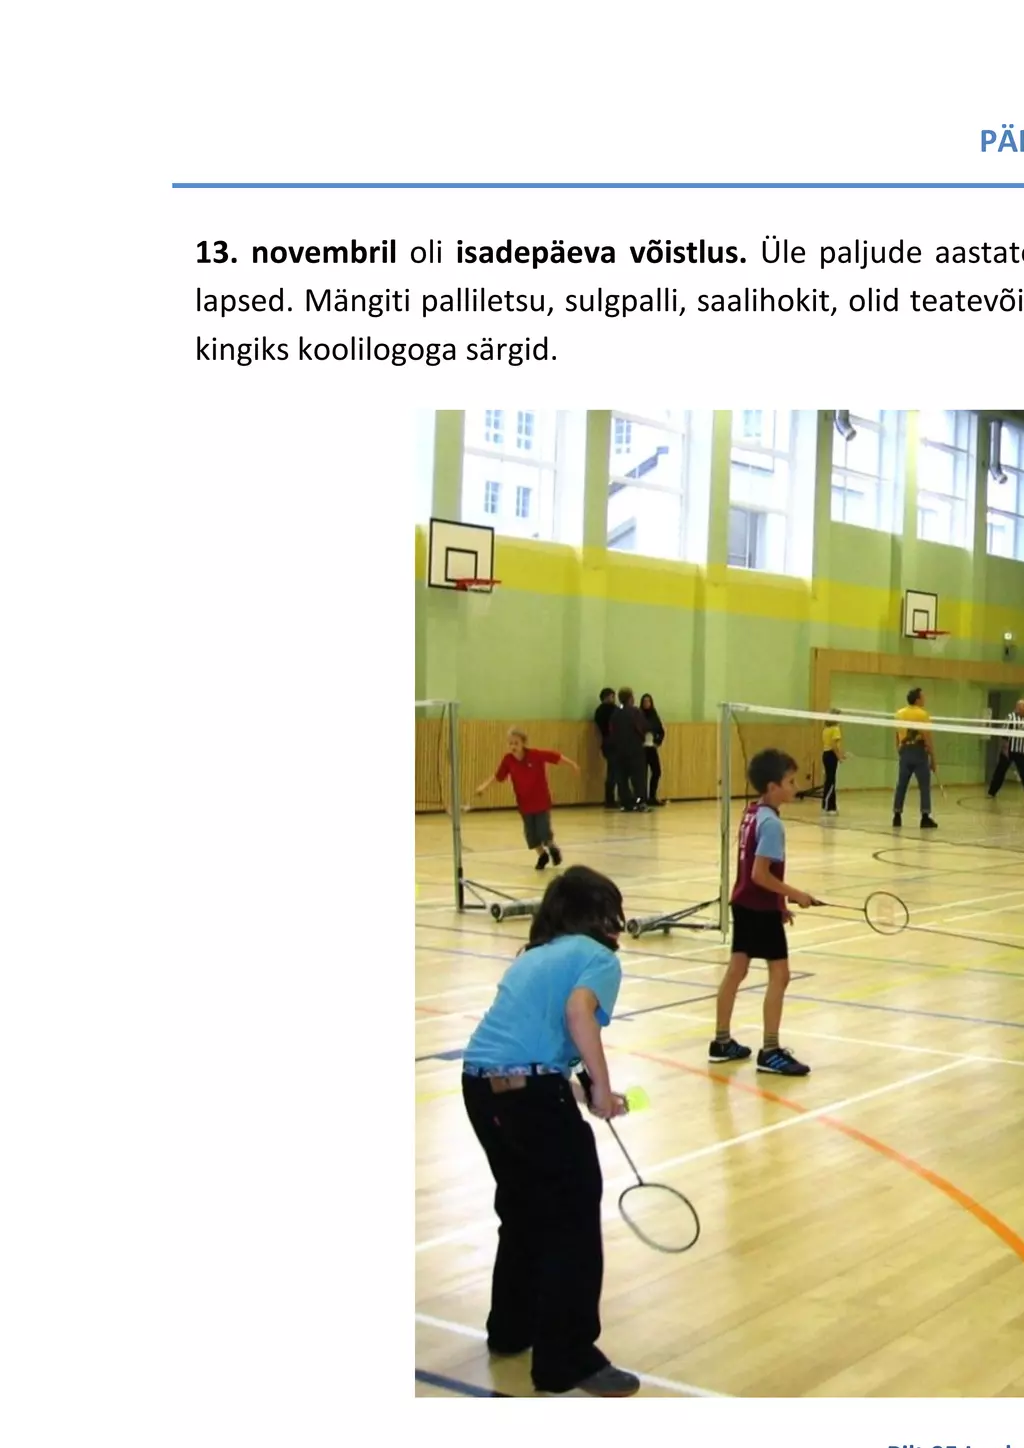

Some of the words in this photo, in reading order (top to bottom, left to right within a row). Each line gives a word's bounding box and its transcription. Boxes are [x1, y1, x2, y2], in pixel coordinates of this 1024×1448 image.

[196, 239, 238, 264] 13.
[252, 238, 396, 264] novembril
[410, 238, 442, 264] oli
[456, 238, 616, 270] isadepäeva
[629, 238, 747, 264] võistlus.
[762, 234, 806, 264] Üle
[820, 238, 922, 270] paljude
[196, 286, 293, 318] lapsed.
[305, 288, 410, 318] Mängiti
[422, 286, 554, 318] palliletsu,
[565, 286, 686, 318] sulgpalli,
[697, 286, 838, 317] saalihokit,
[848, 287, 899, 313] olid
[196, 335, 289, 367] kingiks
[298, 335, 457, 367] koolilogoga
[466, 335, 557, 367] särgid.
